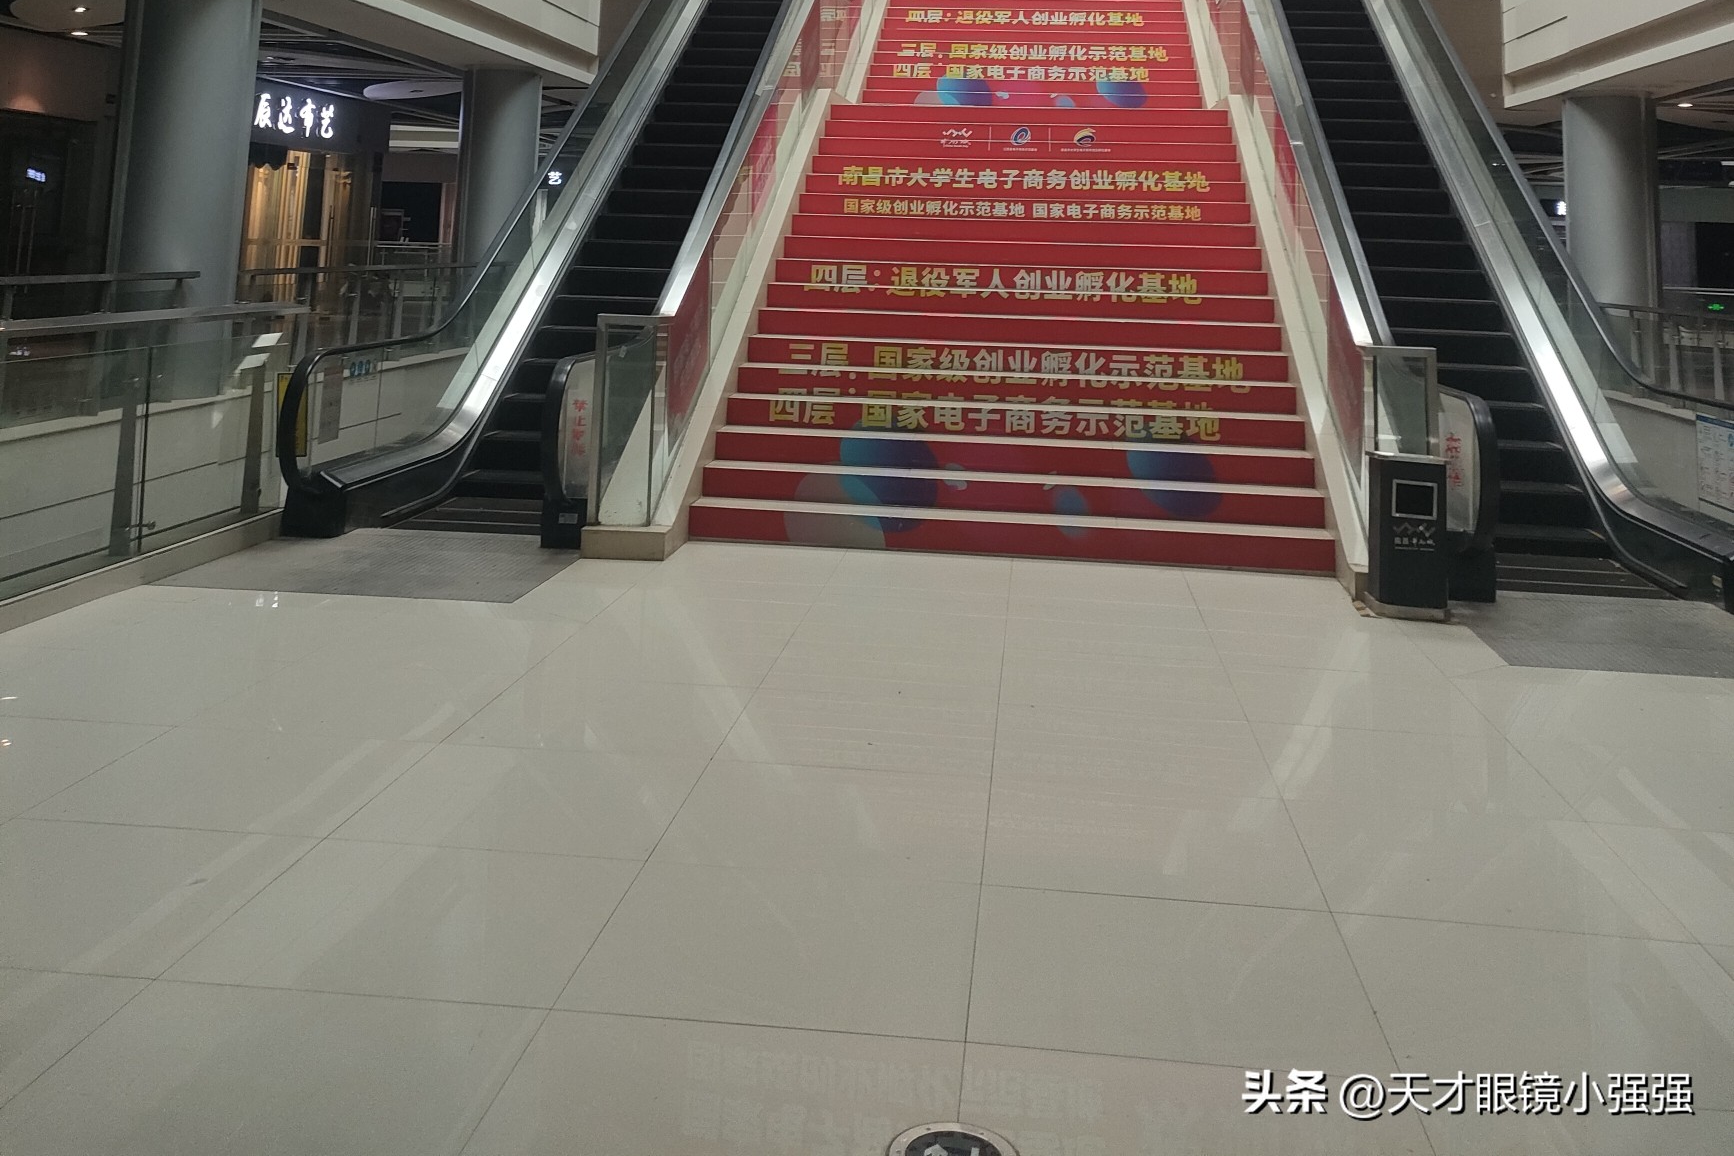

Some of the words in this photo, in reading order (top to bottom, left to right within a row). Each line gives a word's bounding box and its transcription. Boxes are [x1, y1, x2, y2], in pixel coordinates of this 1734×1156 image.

[838, 164, 1211, 194] 南昌市大学生电子商务创业孵化基地
[843, 197, 1027, 220] 国家级创业孵化示范基地
[1031, 201, 1203, 223] 国家电子商务示范基地
